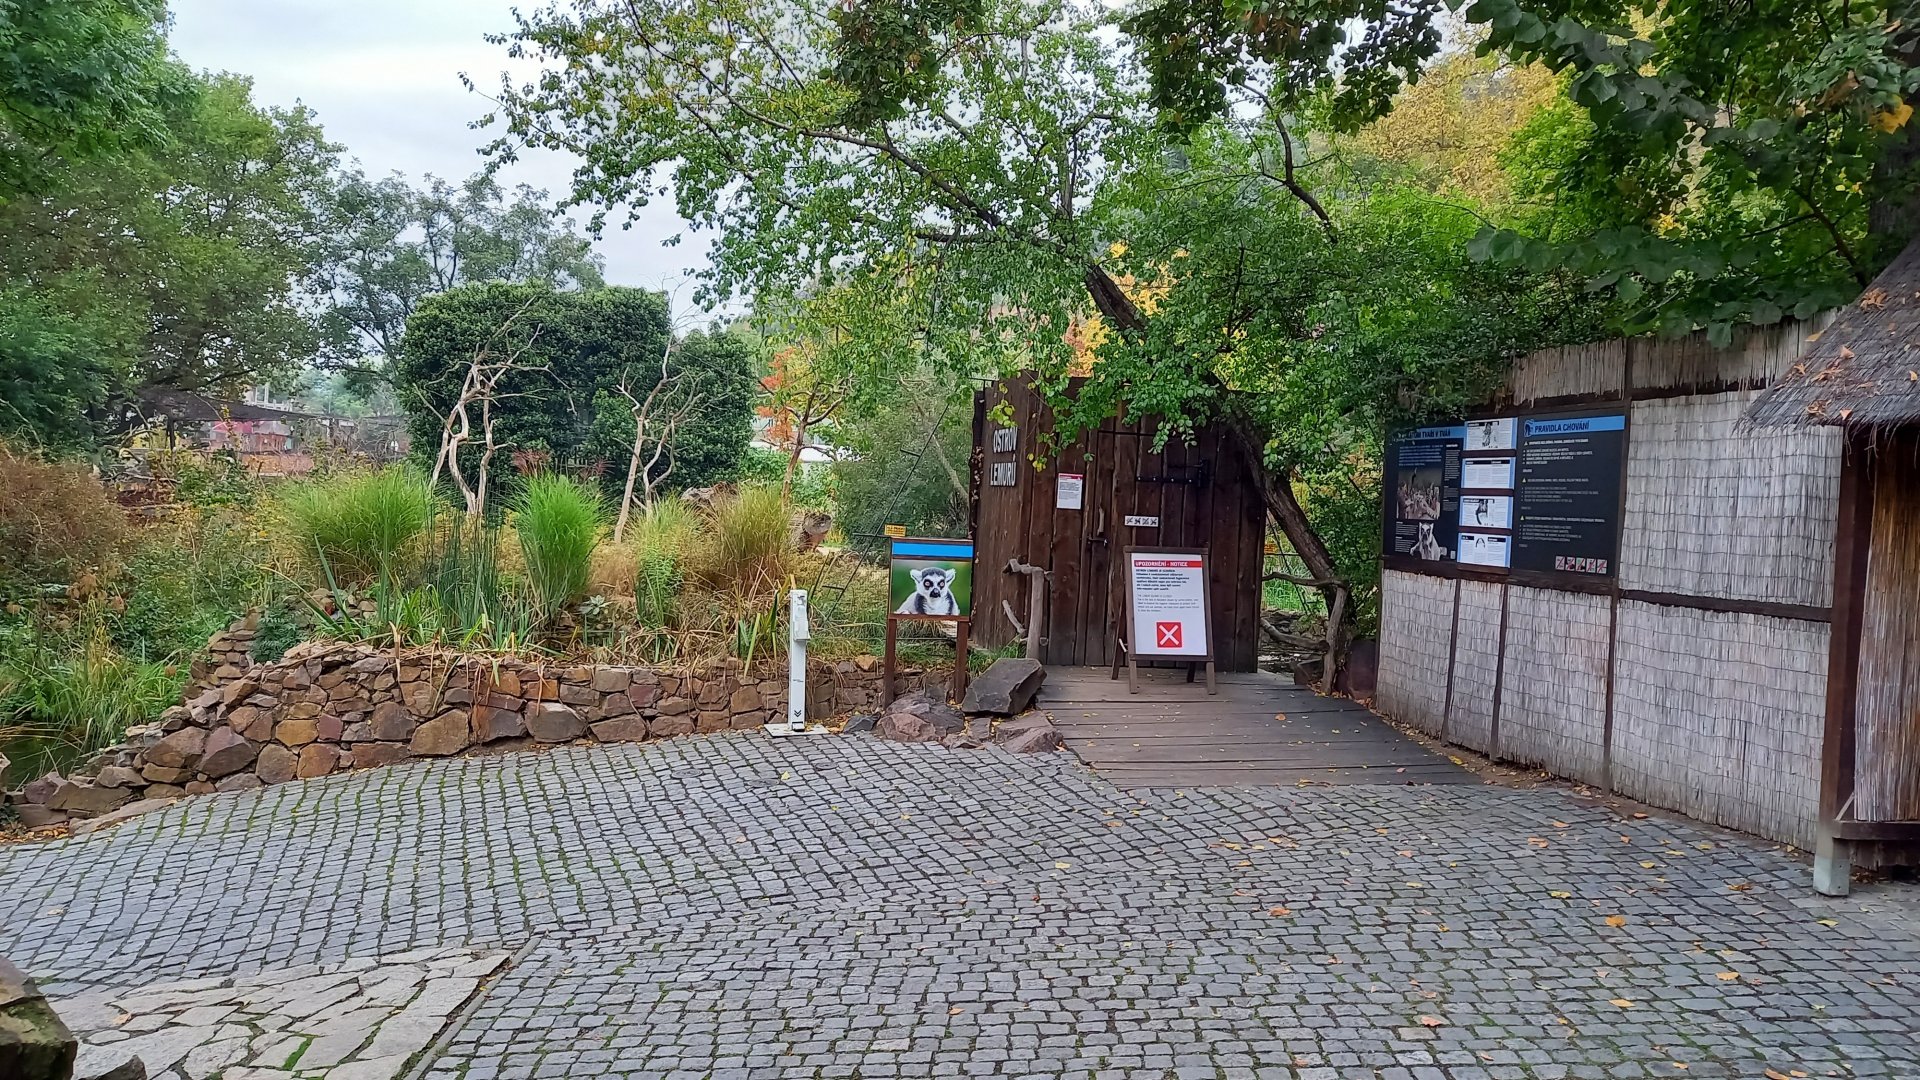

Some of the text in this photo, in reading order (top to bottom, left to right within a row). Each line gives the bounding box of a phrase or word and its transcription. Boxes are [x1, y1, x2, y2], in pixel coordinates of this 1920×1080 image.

[1534, 419, 1590, 433] PRAVIDLA CHOVÁNÍ
[993, 426, 1018, 453] OSTROV
